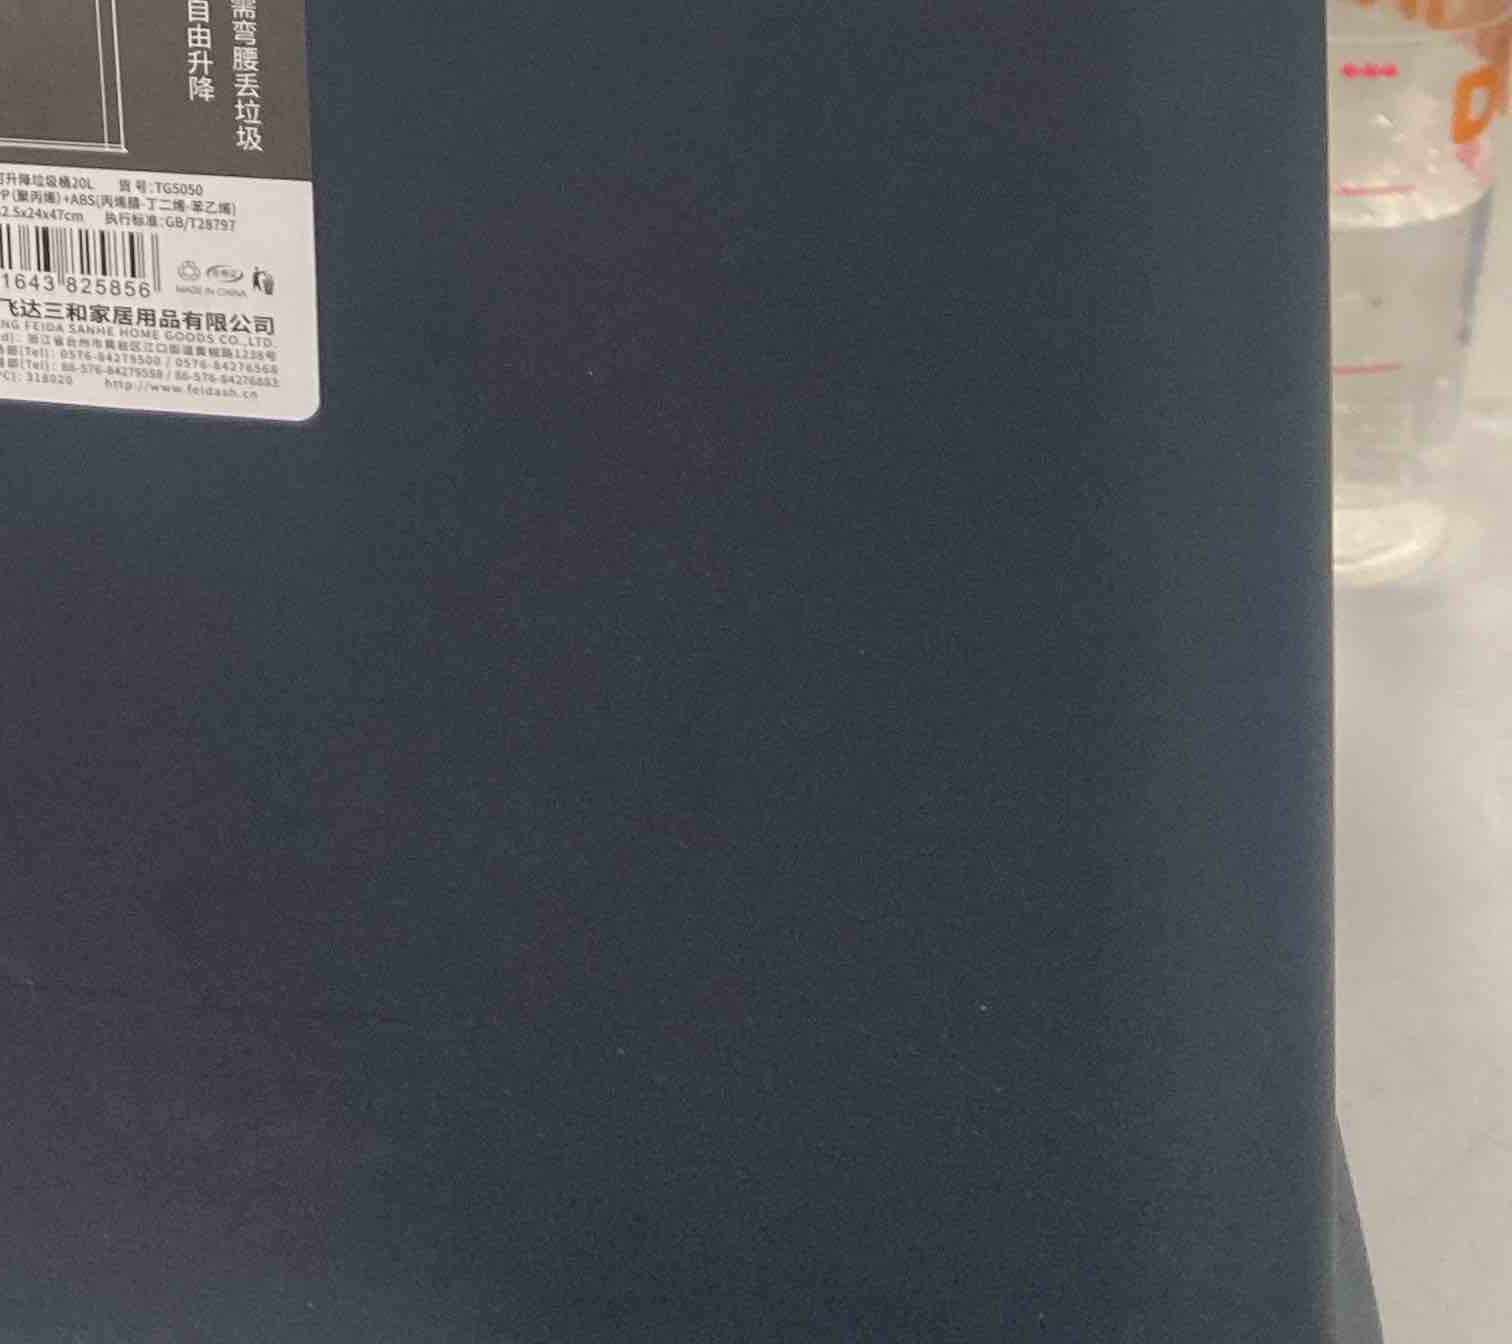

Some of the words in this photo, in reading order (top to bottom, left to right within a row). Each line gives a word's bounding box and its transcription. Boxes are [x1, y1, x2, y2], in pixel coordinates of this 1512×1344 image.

[24, 319, 65, 333] FEIDA
[68, 322, 115, 336] SANHE
[119, 327, 160, 341] HOME
[165, 329, 215, 344] GOODS
